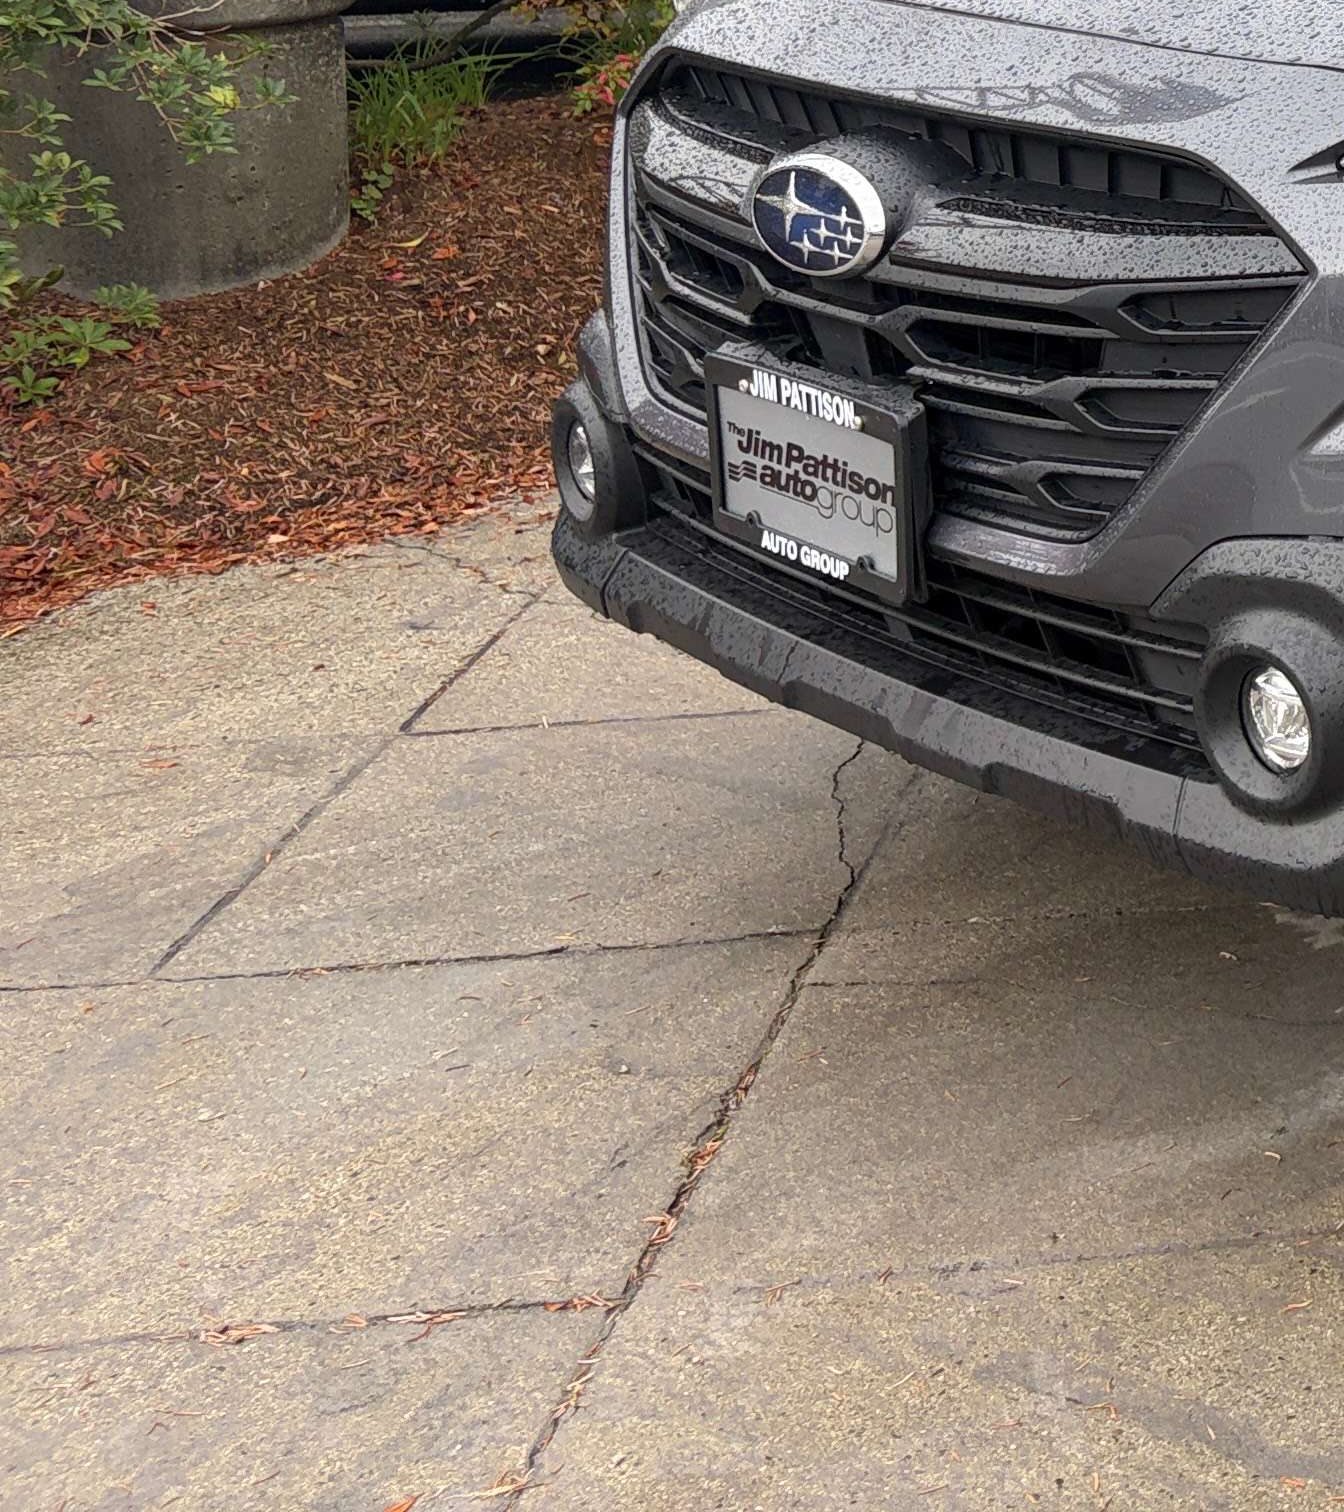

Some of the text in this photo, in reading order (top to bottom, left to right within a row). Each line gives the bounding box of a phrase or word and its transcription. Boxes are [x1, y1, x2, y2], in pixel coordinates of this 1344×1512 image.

[750, 369, 856, 430] JIM PATTISON
[727, 420, 746, 437] The
[761, 530, 850, 580] AUTO GROUP
